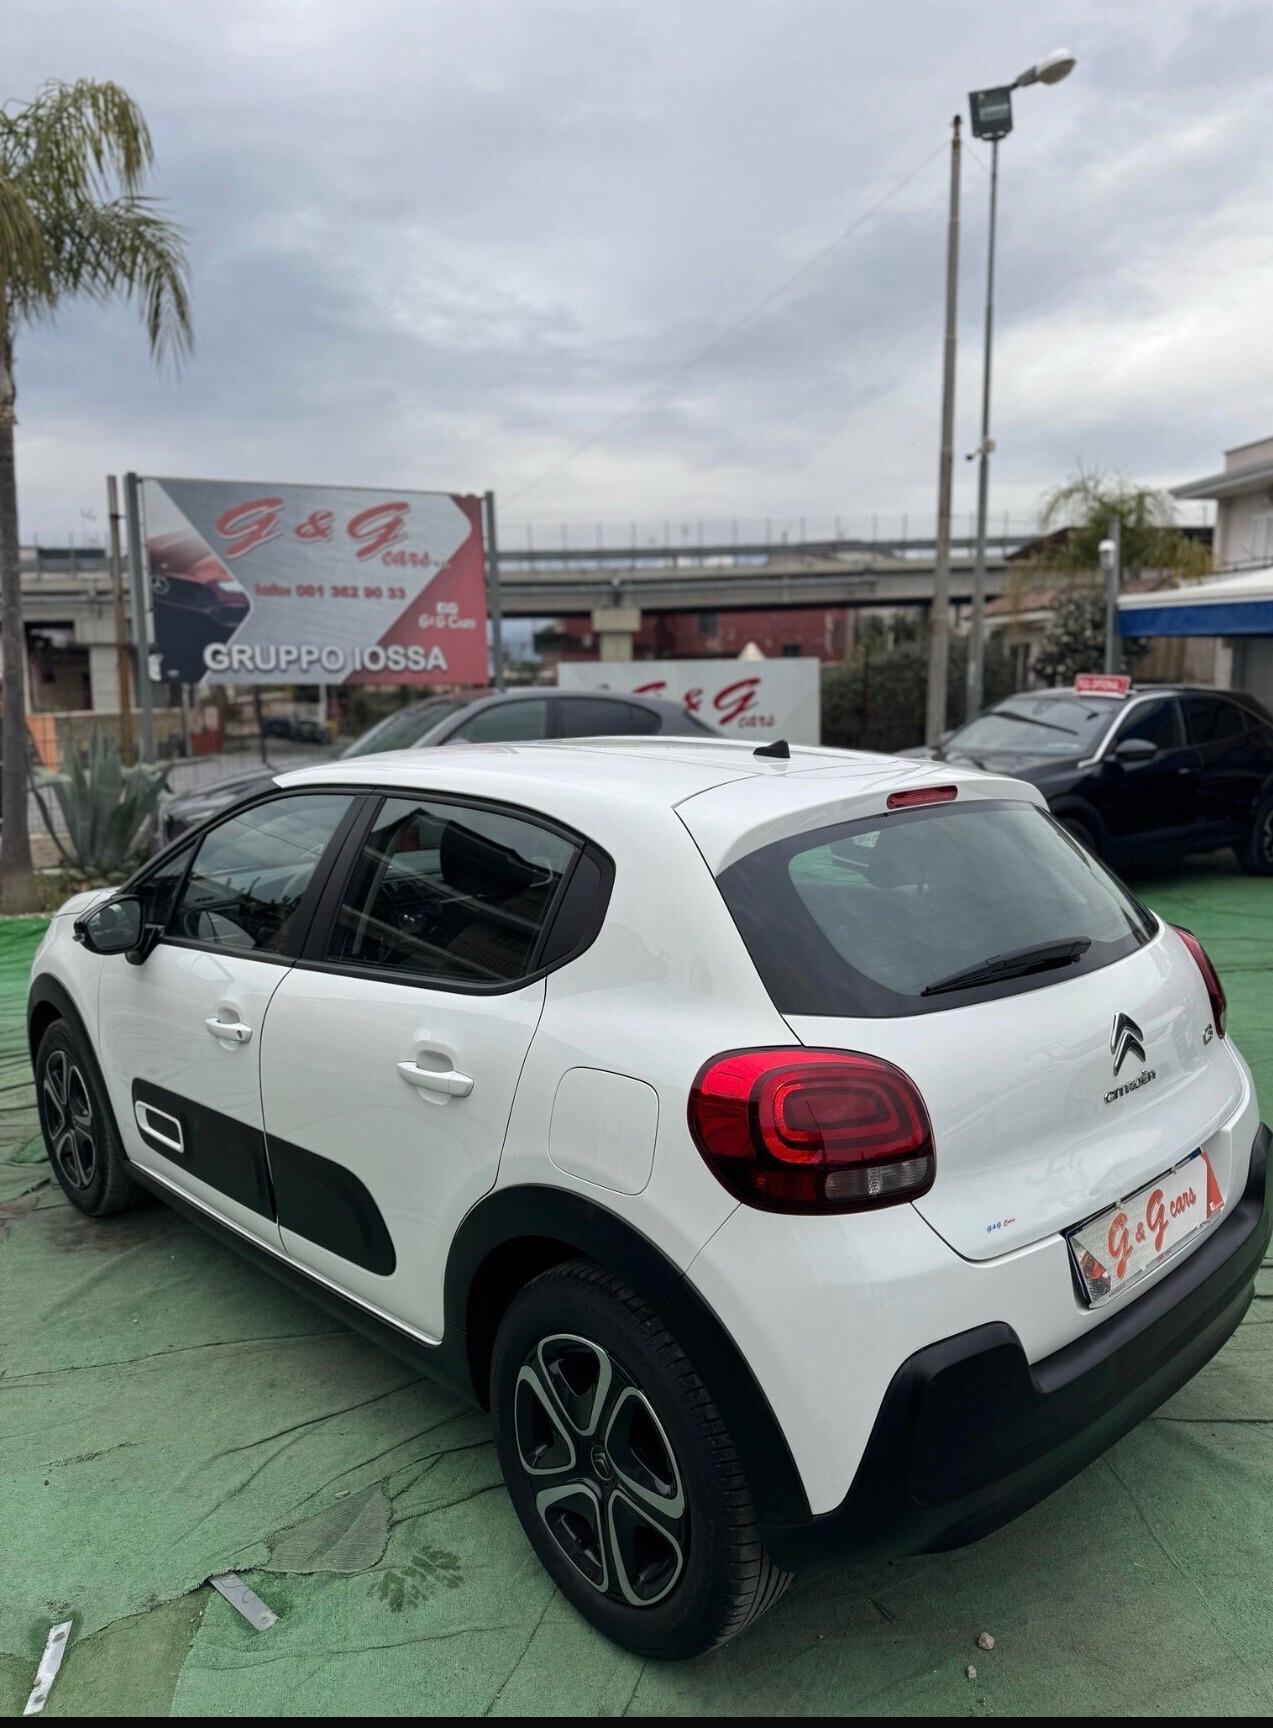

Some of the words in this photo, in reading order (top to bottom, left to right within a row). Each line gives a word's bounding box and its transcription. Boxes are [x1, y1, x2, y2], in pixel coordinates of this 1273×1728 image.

[216, 497, 284, 559] G
[294, 510, 335, 542] &
[346, 501, 410, 560] G
[203, 643, 345, 673] GRUPPO
[354, 645, 449, 672] IOSSA
[713, 676, 761, 725] G
[1107, 1211, 1134, 1281] G
[1135, 1222, 1147, 1244] &
[1146, 1188, 1170, 1252] G
[1170, 1187, 1197, 1218] cars
